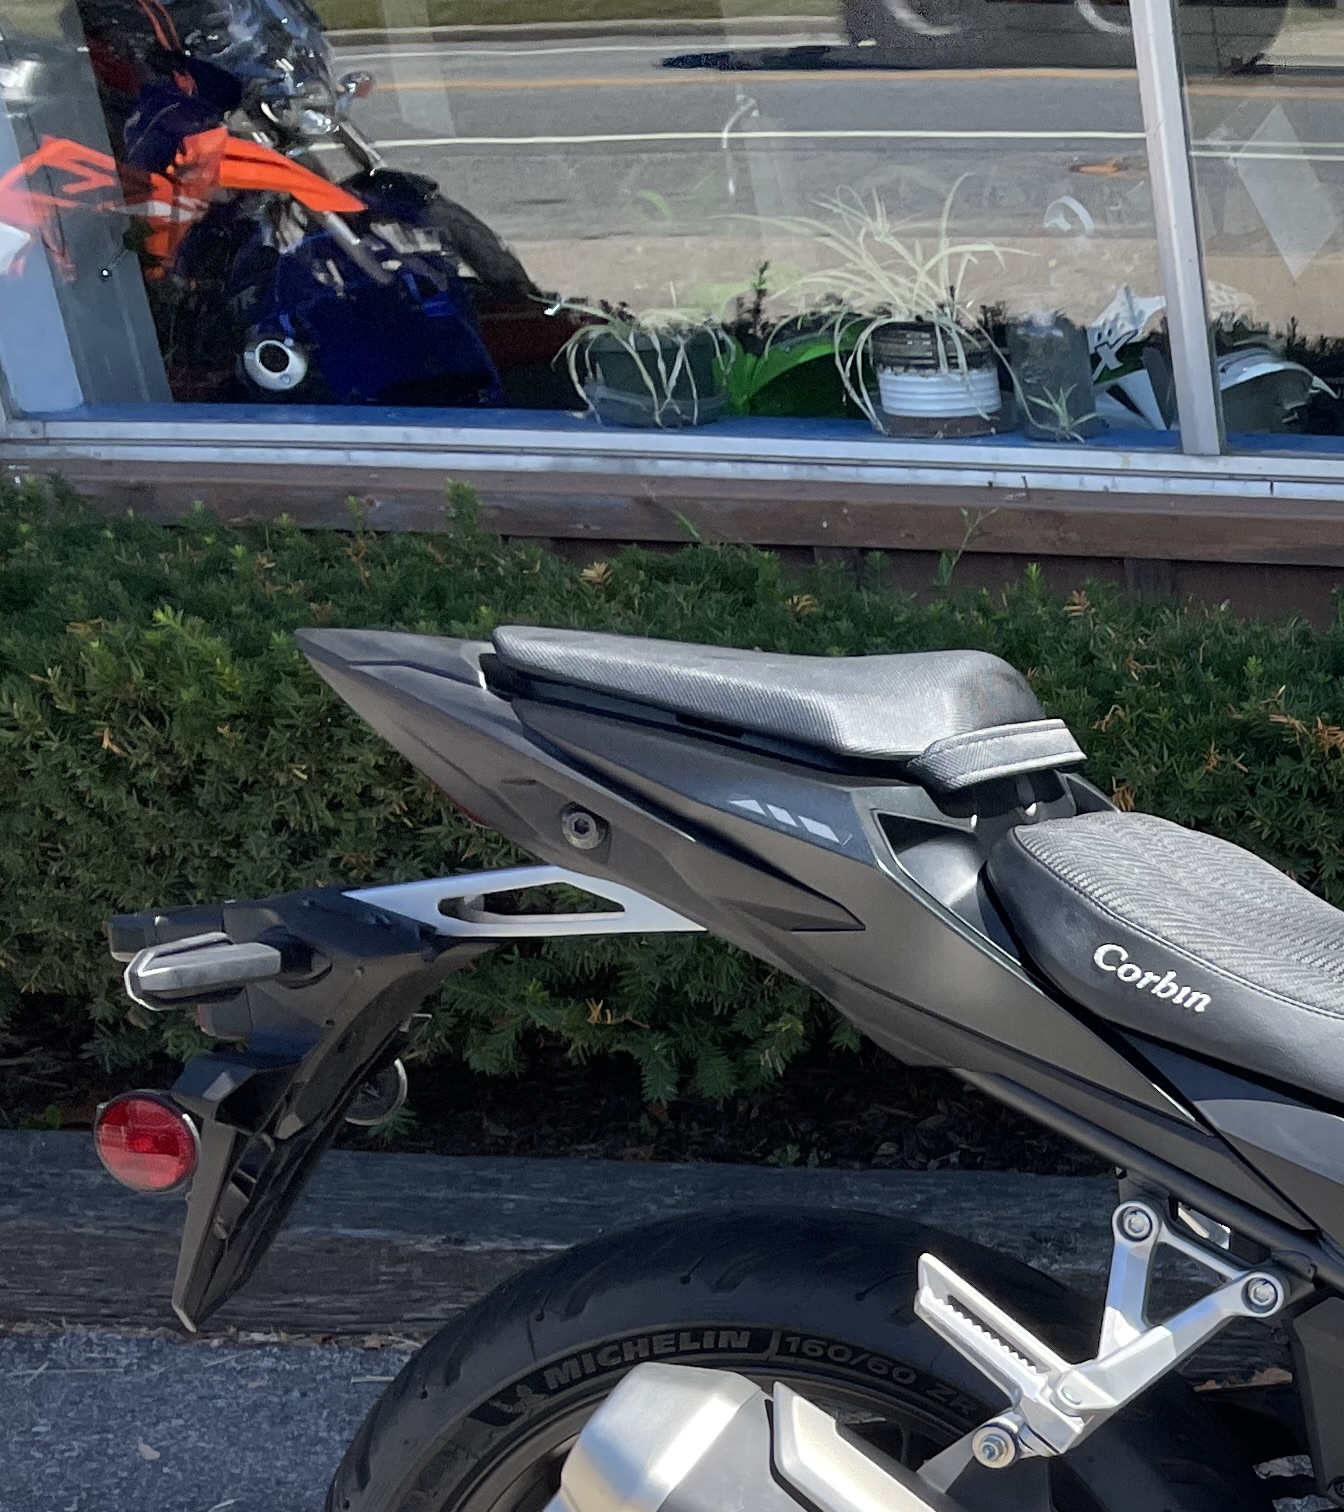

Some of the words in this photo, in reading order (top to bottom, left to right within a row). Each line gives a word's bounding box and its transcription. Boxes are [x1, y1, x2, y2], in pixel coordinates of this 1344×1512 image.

[1094, 944, 1211, 1012] Corbin
[543, 1330, 750, 1390] MICHELIN
[786, 1336, 917, 1385] 160/60
